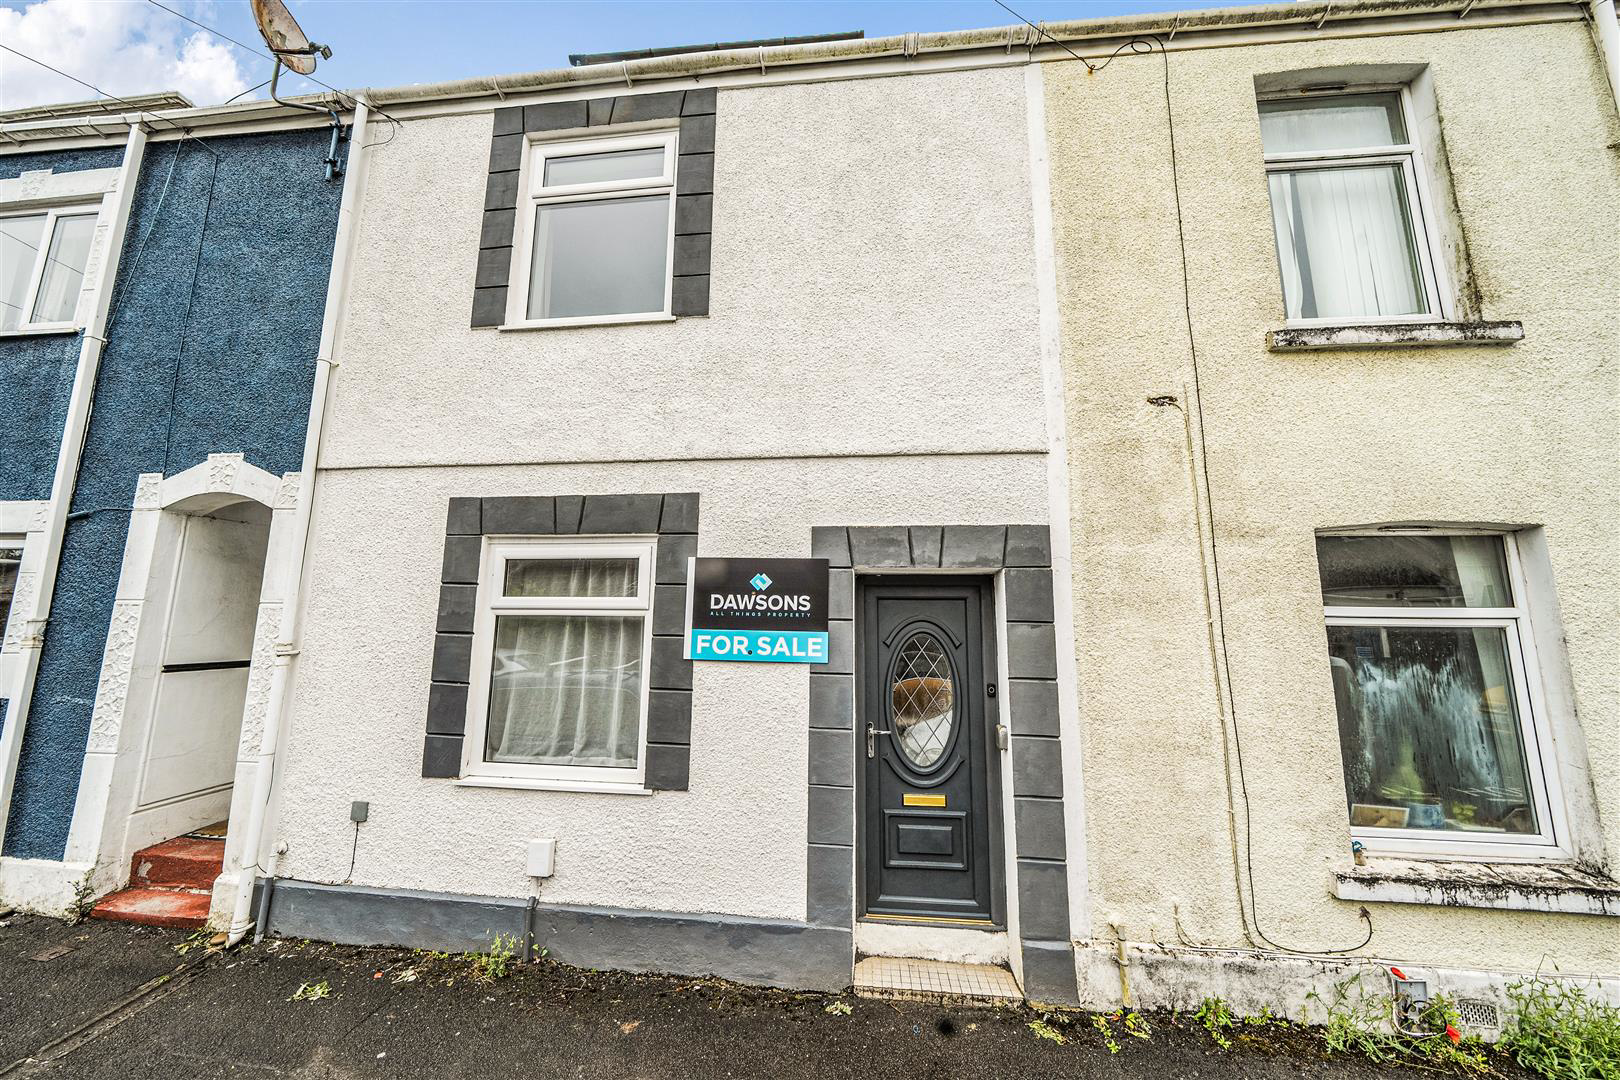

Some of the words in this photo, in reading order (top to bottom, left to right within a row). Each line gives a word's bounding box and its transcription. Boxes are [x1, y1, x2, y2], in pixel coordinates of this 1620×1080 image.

[710, 594, 811, 611] DAWSONS
[696, 635, 748, 655] FOR
[756, 636, 823, 657] SALE
